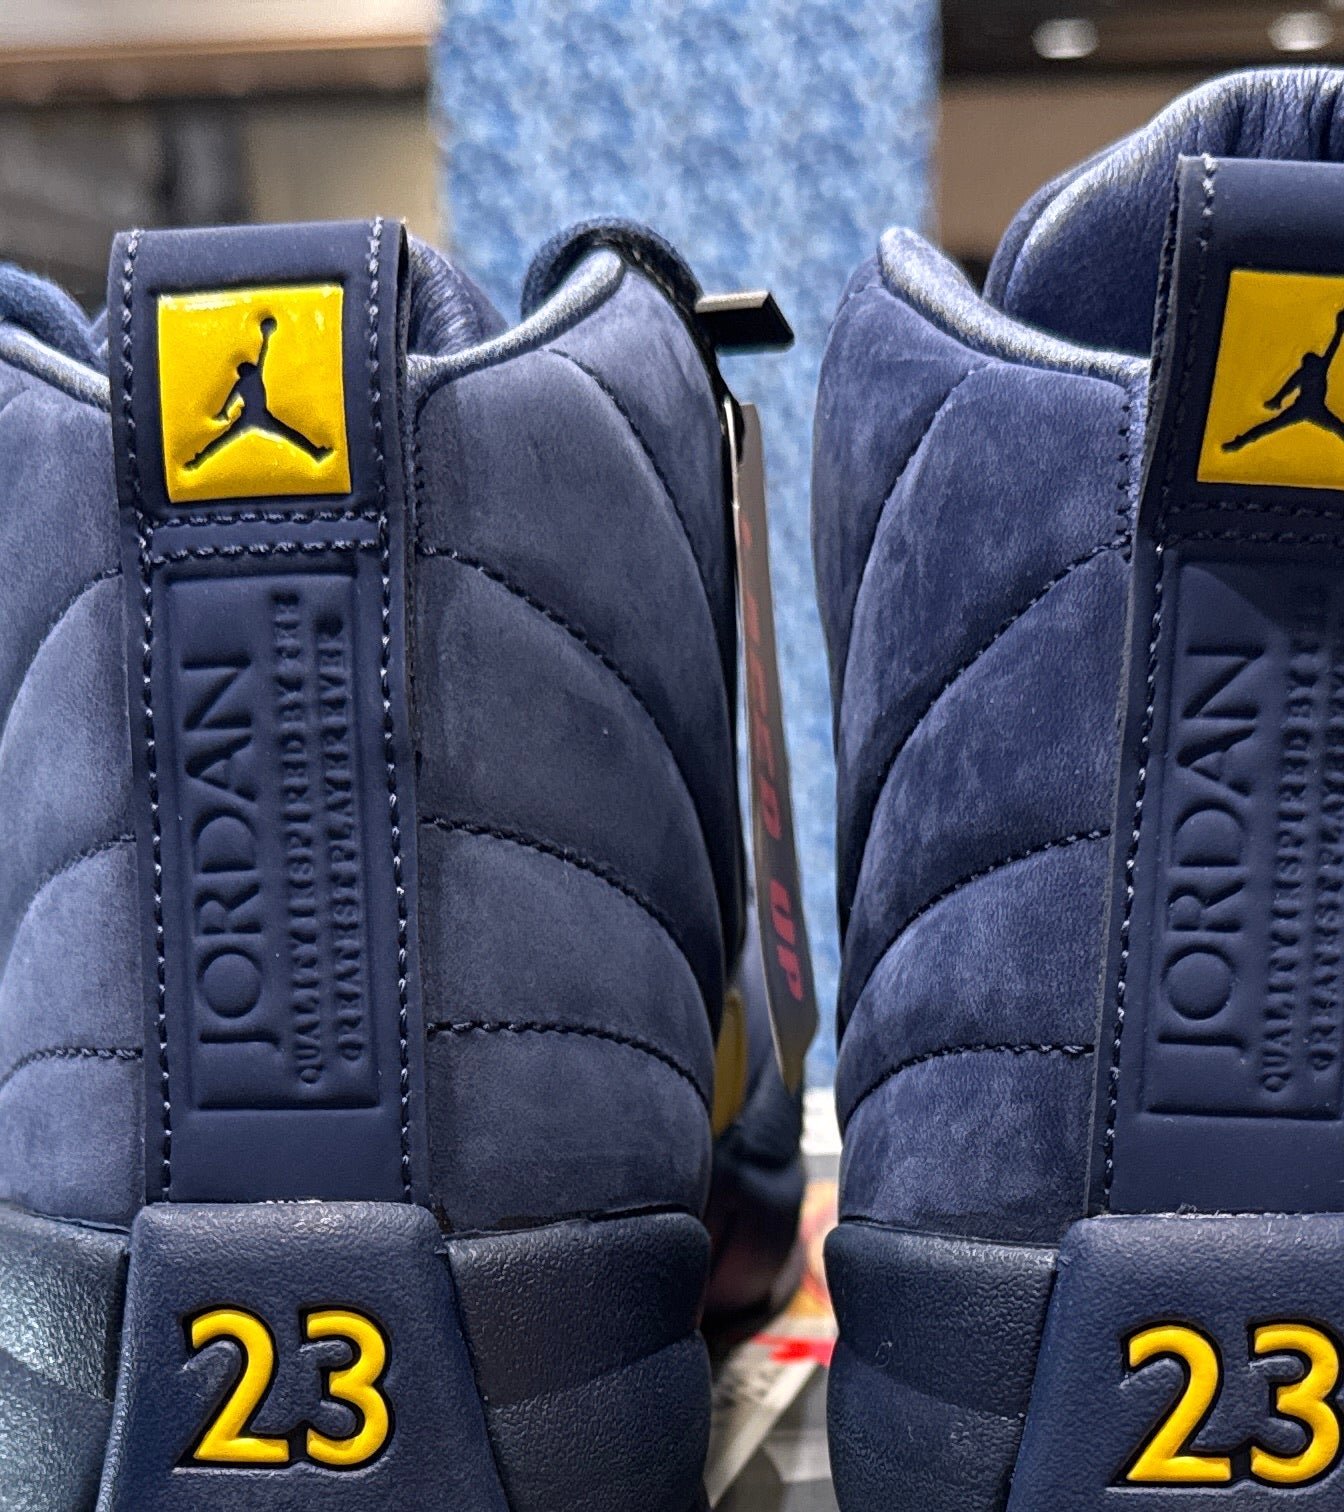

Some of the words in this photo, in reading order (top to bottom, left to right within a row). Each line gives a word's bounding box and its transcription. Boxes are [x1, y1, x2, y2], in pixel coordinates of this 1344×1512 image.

[273, 677, 305, 729] BY
[312, 620, 351, 727] EVER
[1283, 675, 1316, 727] BY
[180, 656, 283, 1050] JORDAN
[278, 734, 317, 926] INSPIRED
[318, 729, 358, 876] PLAYER
[1157, 643, 1265, 1052] JORDAN
[1271, 731, 1312, 924] INSPIRED
[286, 929, 324, 1086] QUALITY
[325, 878, 364, 1066] GREATEST
[767, 876, 805, 1001] UP
[1259, 928, 1302, 1094] QUALITY
[1306, 877, 1343, 1073] GREATEST
[186, 1307, 394, 1465] 23
